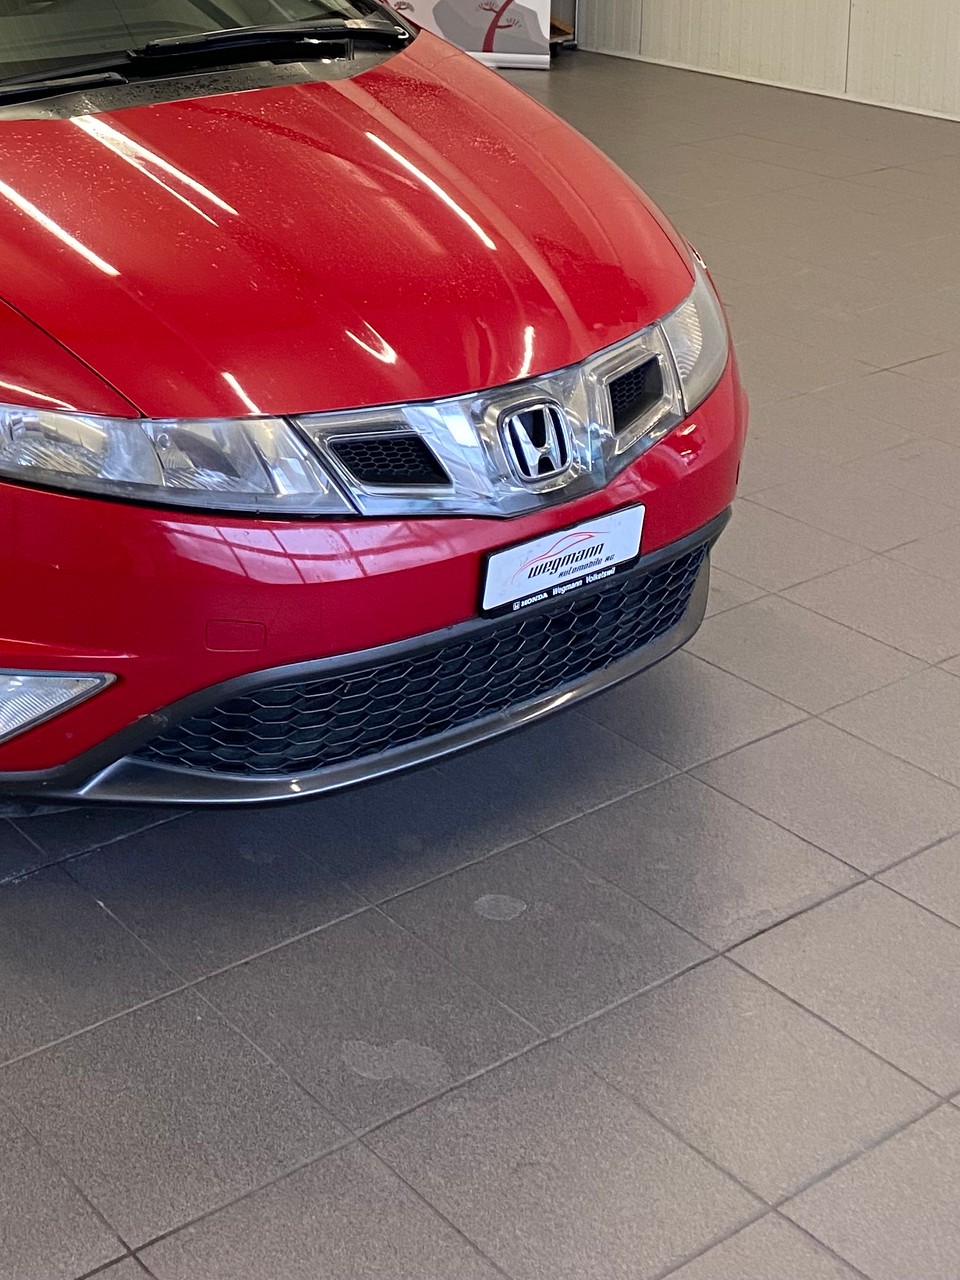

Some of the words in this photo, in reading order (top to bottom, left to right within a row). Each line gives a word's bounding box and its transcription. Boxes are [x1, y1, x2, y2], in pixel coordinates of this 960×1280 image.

[528, 543, 604, 579] wegmann
[521, 592, 549, 608] HONDA
[552, 579, 583, 596] Wegmann
